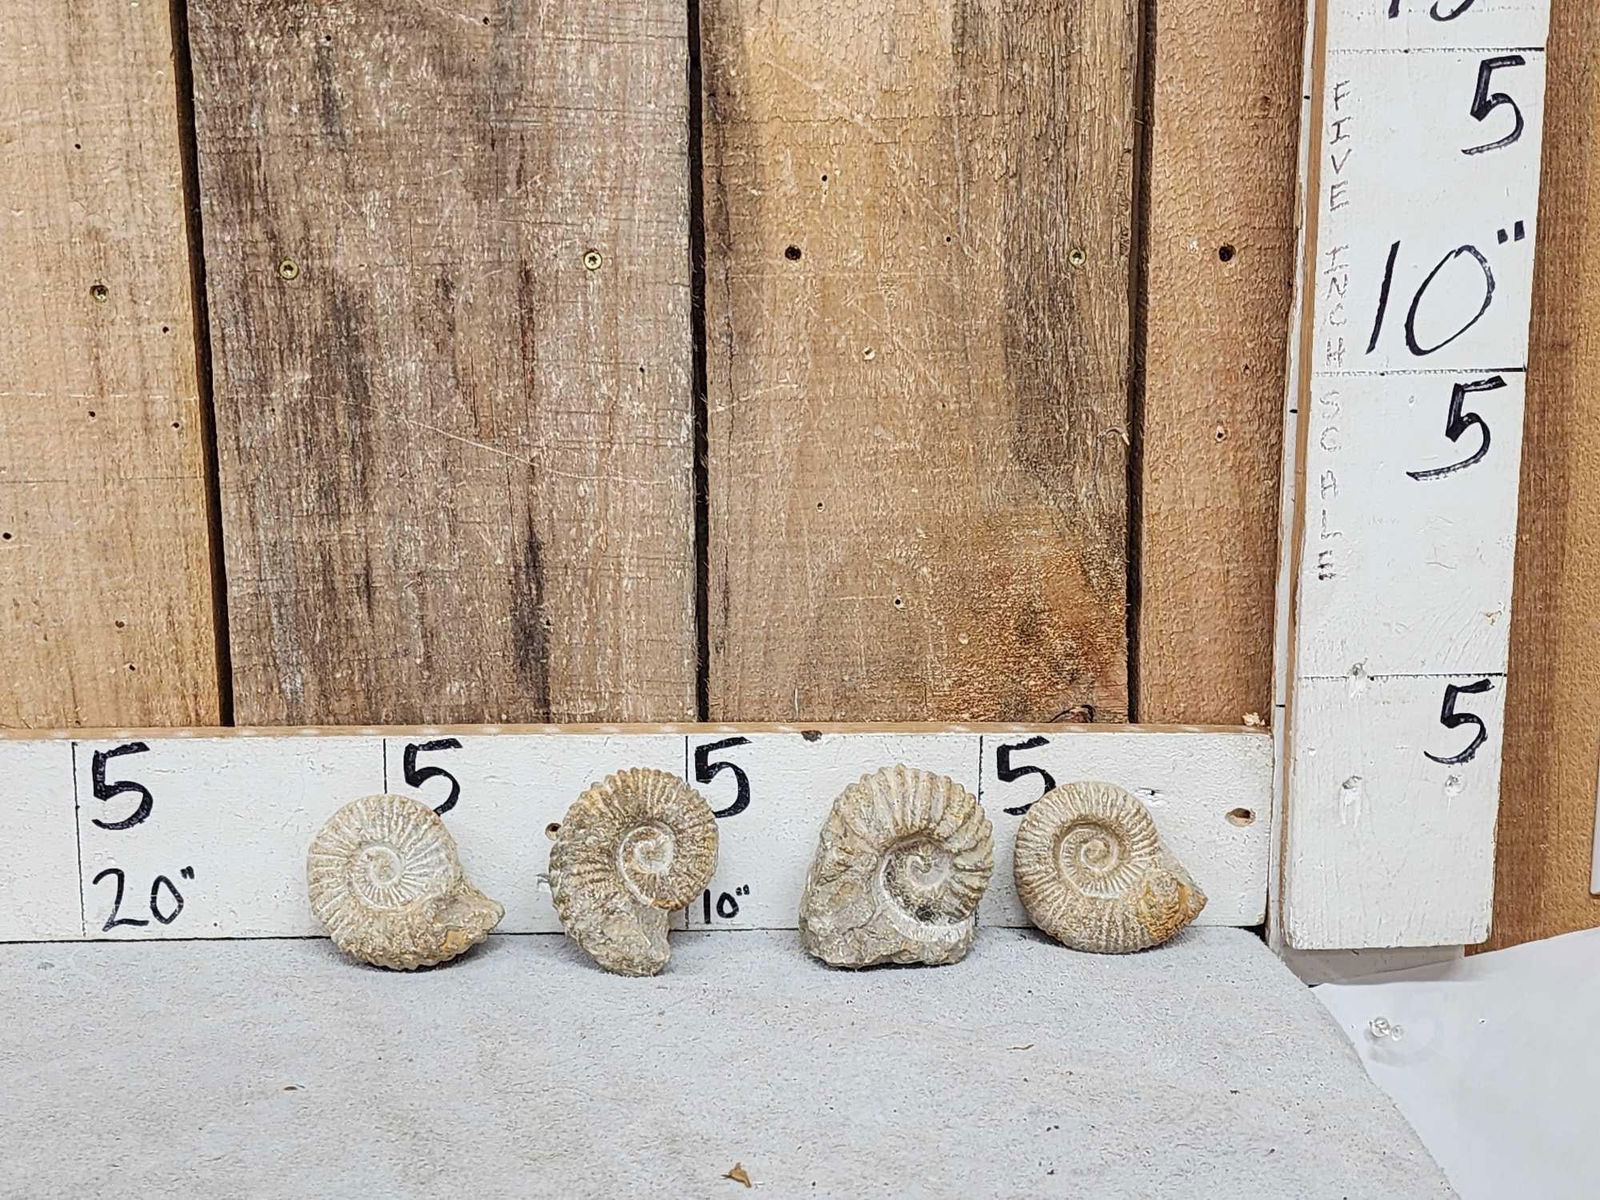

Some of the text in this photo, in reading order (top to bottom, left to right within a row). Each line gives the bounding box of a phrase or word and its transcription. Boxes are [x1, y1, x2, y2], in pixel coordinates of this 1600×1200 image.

[1329, 79, 1353, 213] FIVE
[1461, 54, 1525, 156] 5
[1406, 375, 1508, 482] 5
[1423, 678, 1496, 766] 5
[90, 740, 155, 830] 5
[403, 737, 463, 816] 5
[694, 735, 753, 819] 5
[995, 735, 1057, 816] 5
[92, 865, 195, 932] 20"
